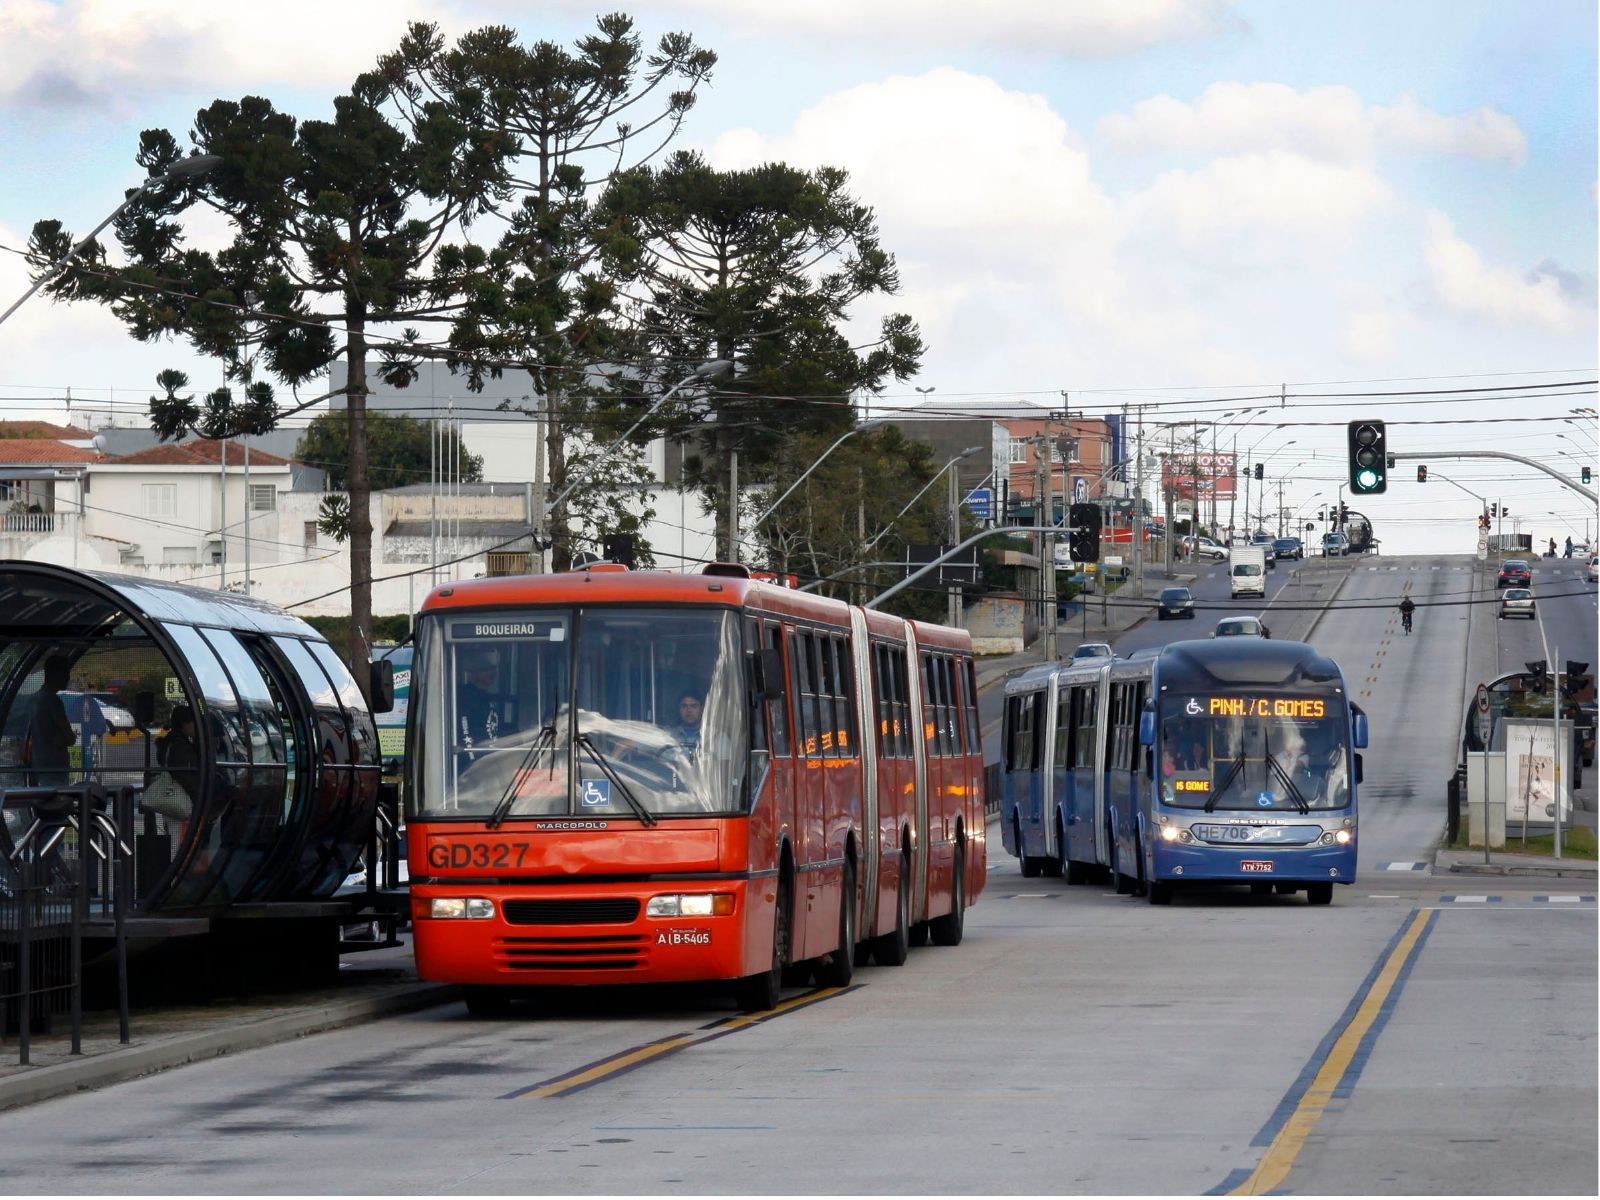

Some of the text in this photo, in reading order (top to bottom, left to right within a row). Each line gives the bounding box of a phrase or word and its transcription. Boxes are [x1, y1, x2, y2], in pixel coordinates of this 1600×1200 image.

[475, 624, 535, 635] BOQUEIRAO
[1274, 700, 1324, 717] GOMES
[1198, 826, 1249, 840] HE706
[429, 843, 530, 868] GD327
